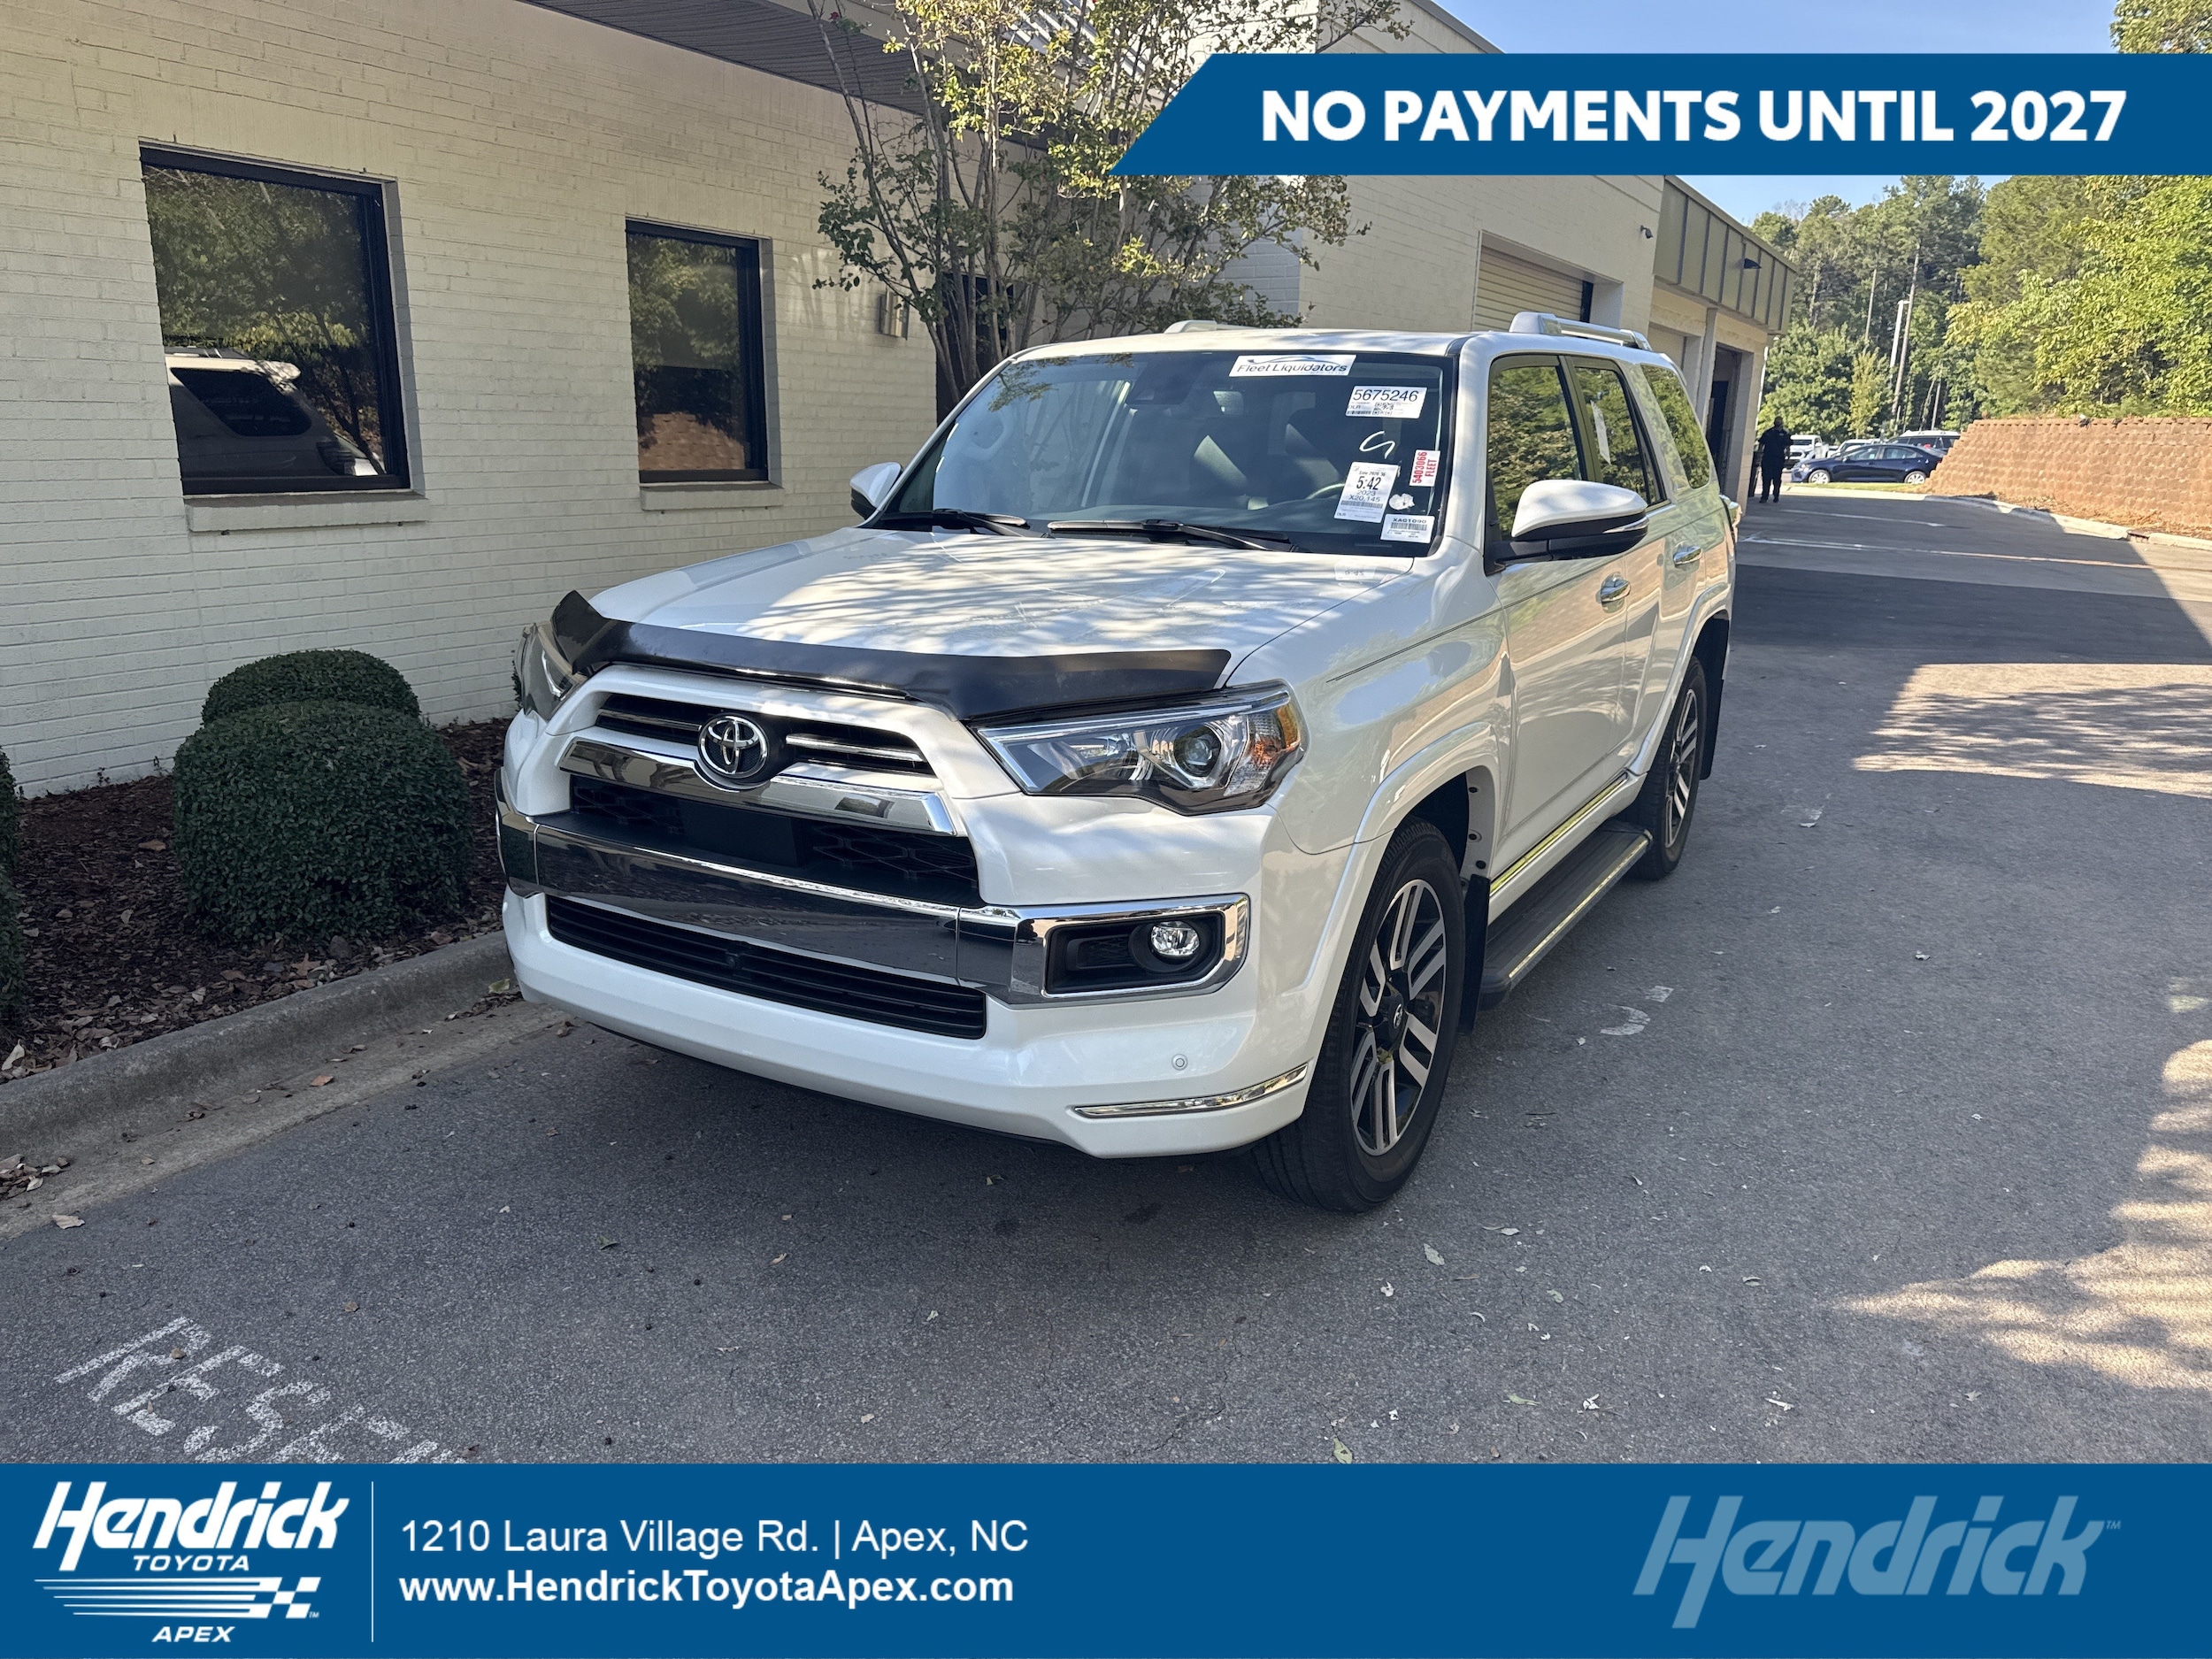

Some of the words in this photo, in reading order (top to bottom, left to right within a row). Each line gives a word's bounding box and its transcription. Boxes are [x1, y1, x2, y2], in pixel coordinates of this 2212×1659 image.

[1237, 364, 1270, 373] Fleet
[1272, 363, 1348, 373] Liquidators
[1353, 388, 1419, 402] 5675246
[1412, 451, 1427, 484] 5403066
[1425, 459, 1437, 477] FLEET
[1356, 476, 1382, 490] 5:42
[53, 1316, 469, 1463] RESE
